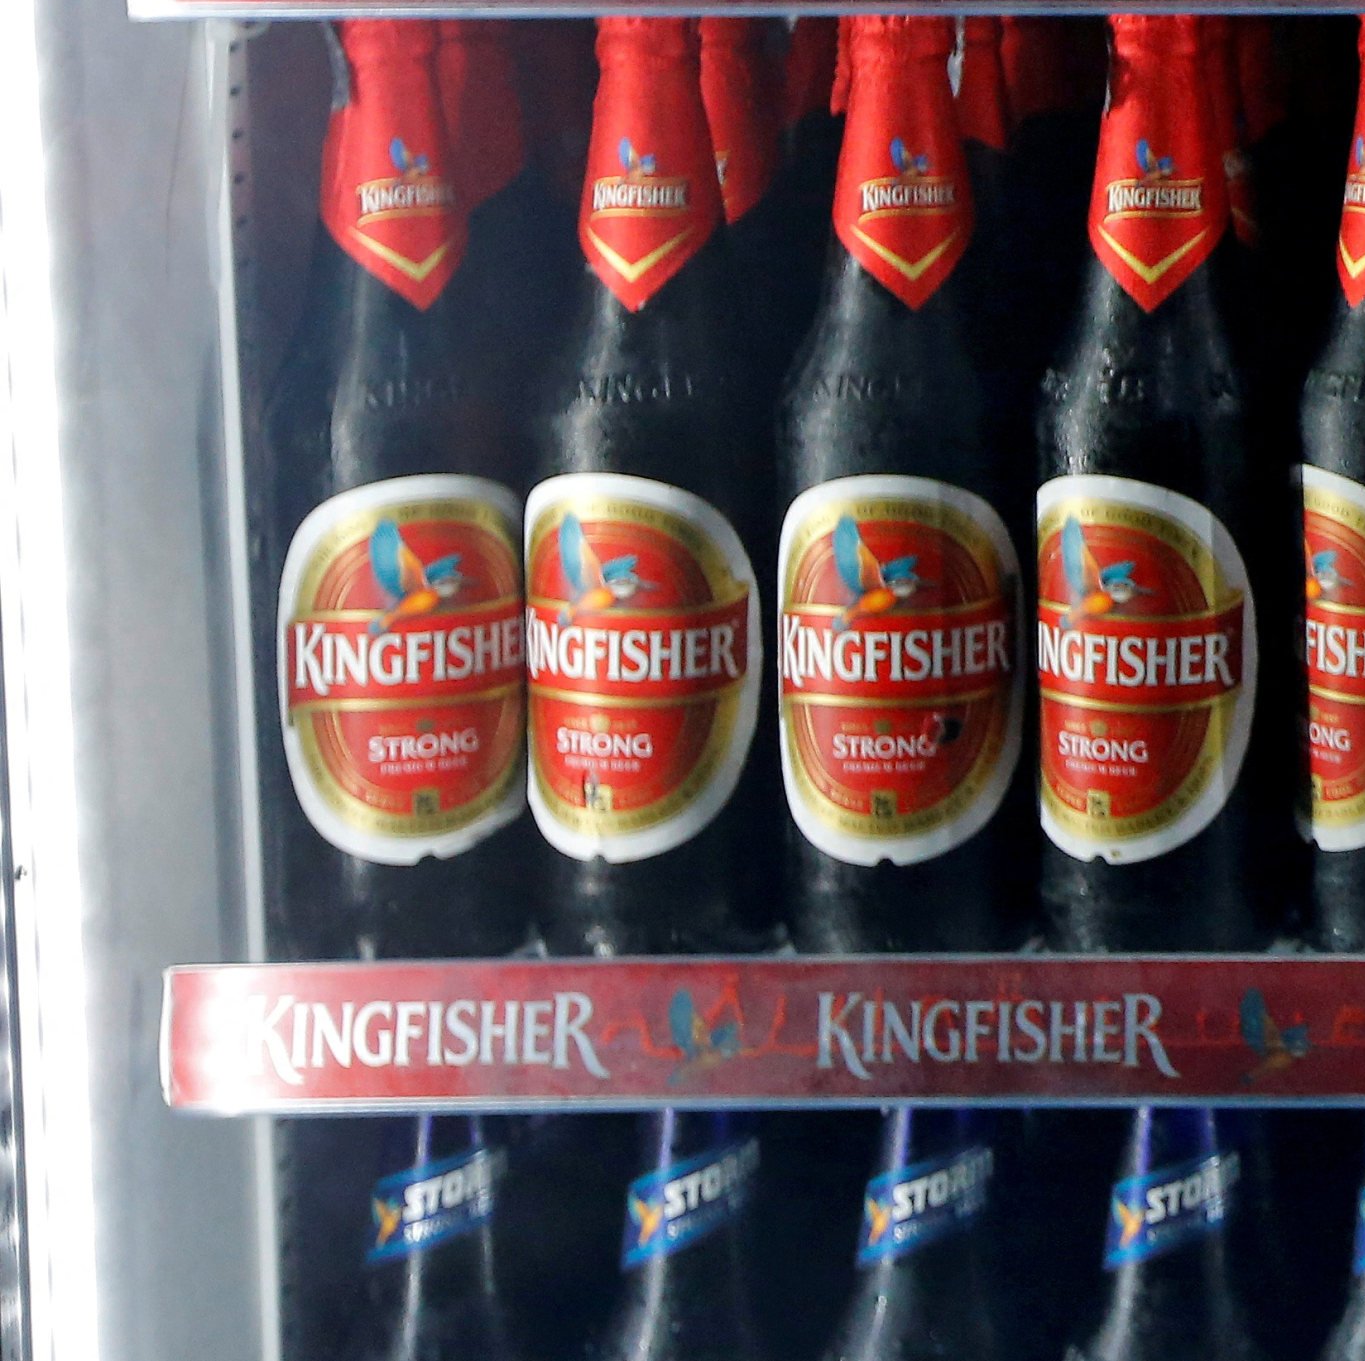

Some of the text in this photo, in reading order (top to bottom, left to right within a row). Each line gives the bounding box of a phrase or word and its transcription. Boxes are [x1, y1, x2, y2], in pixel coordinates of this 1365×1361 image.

[592, 181, 690, 211] KINGFISHER
[862, 181, 956, 211] KINGFISHER
[1107, 181, 1202, 212] KINGFISHER
[783, 614, 1011, 689] KINGFISHER
[368, 728, 478, 762] STRONG
[556, 728, 653, 759] STRONG
[832, 733, 937, 760] STRONG
[1058, 731, 1148, 763] STRONG
[244, 992, 609, 1085] KINGFISHER
[817, 992, 1181, 1080] KINGFISHER
